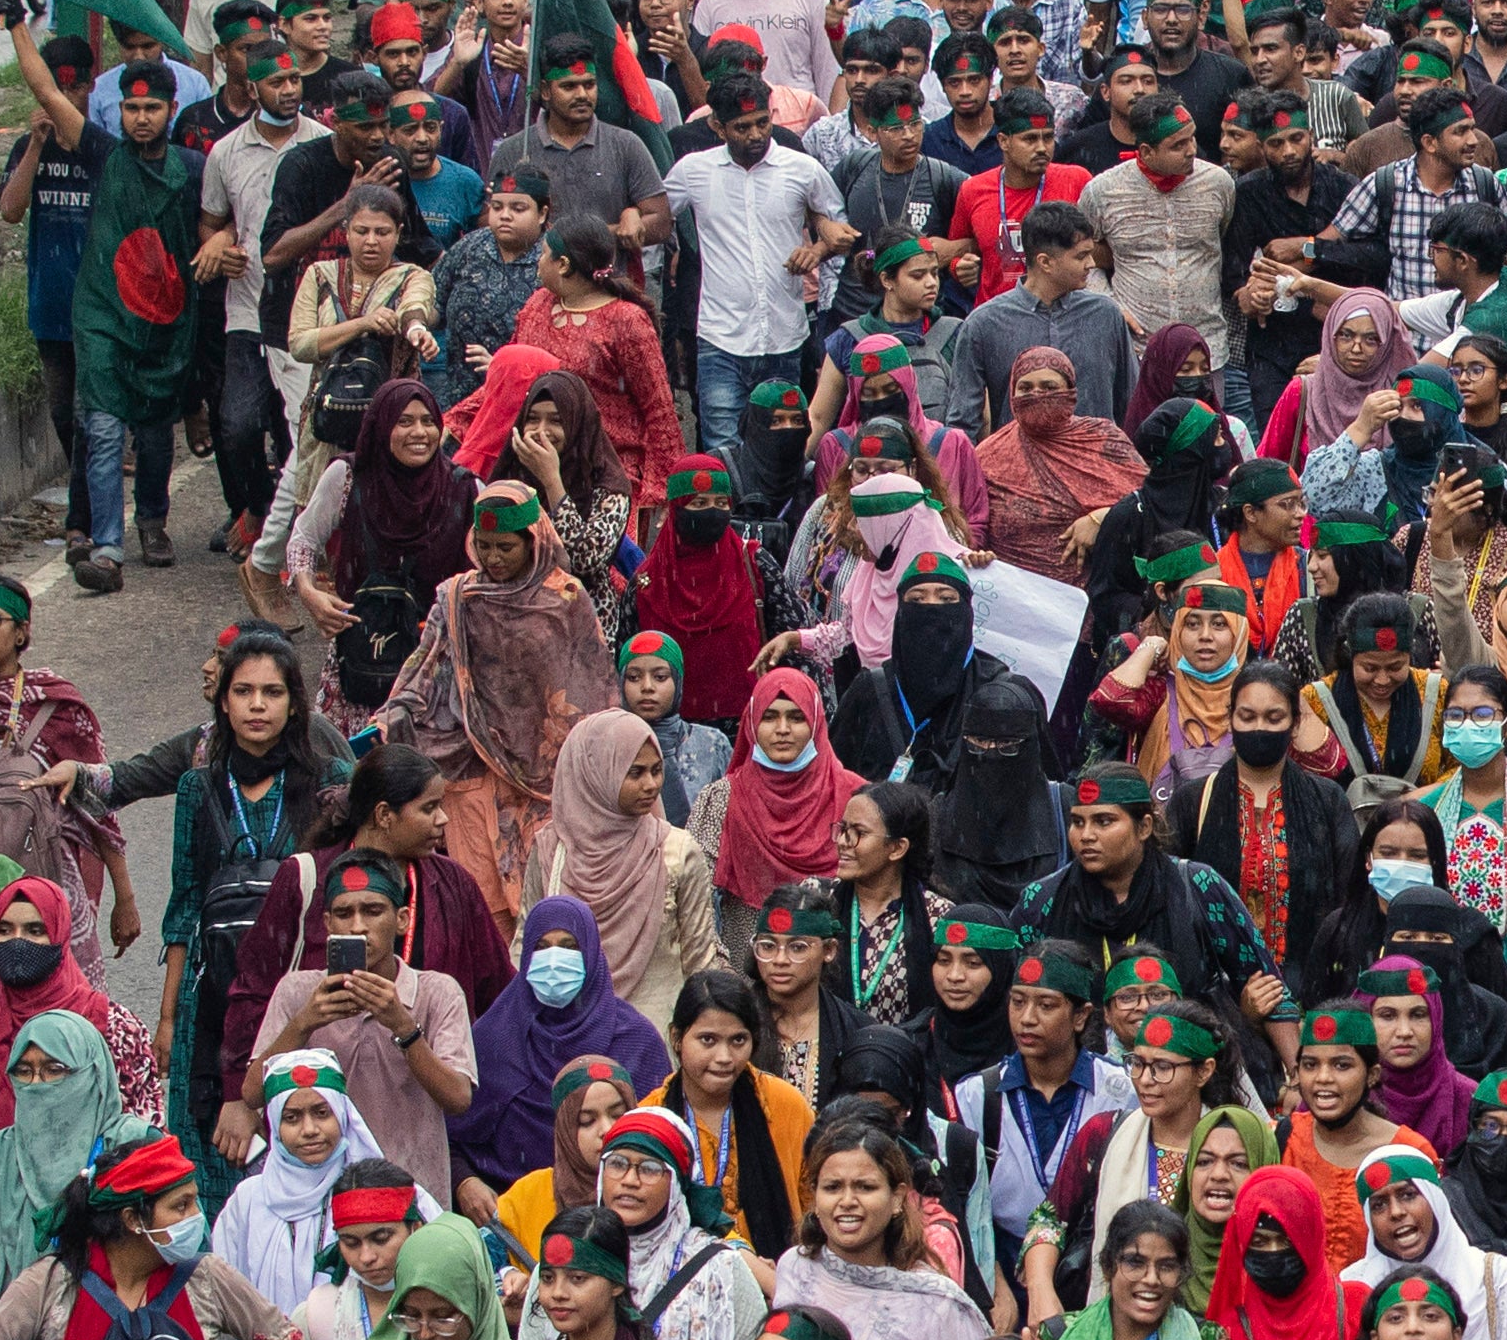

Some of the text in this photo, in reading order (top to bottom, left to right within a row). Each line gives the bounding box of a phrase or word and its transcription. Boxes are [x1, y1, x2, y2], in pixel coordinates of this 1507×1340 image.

[765, 15, 808, 31] Klein
[48, 162, 69, 177] YOU
[907, 202, 932, 215] JUST
[911, 214, 927, 228] DO
